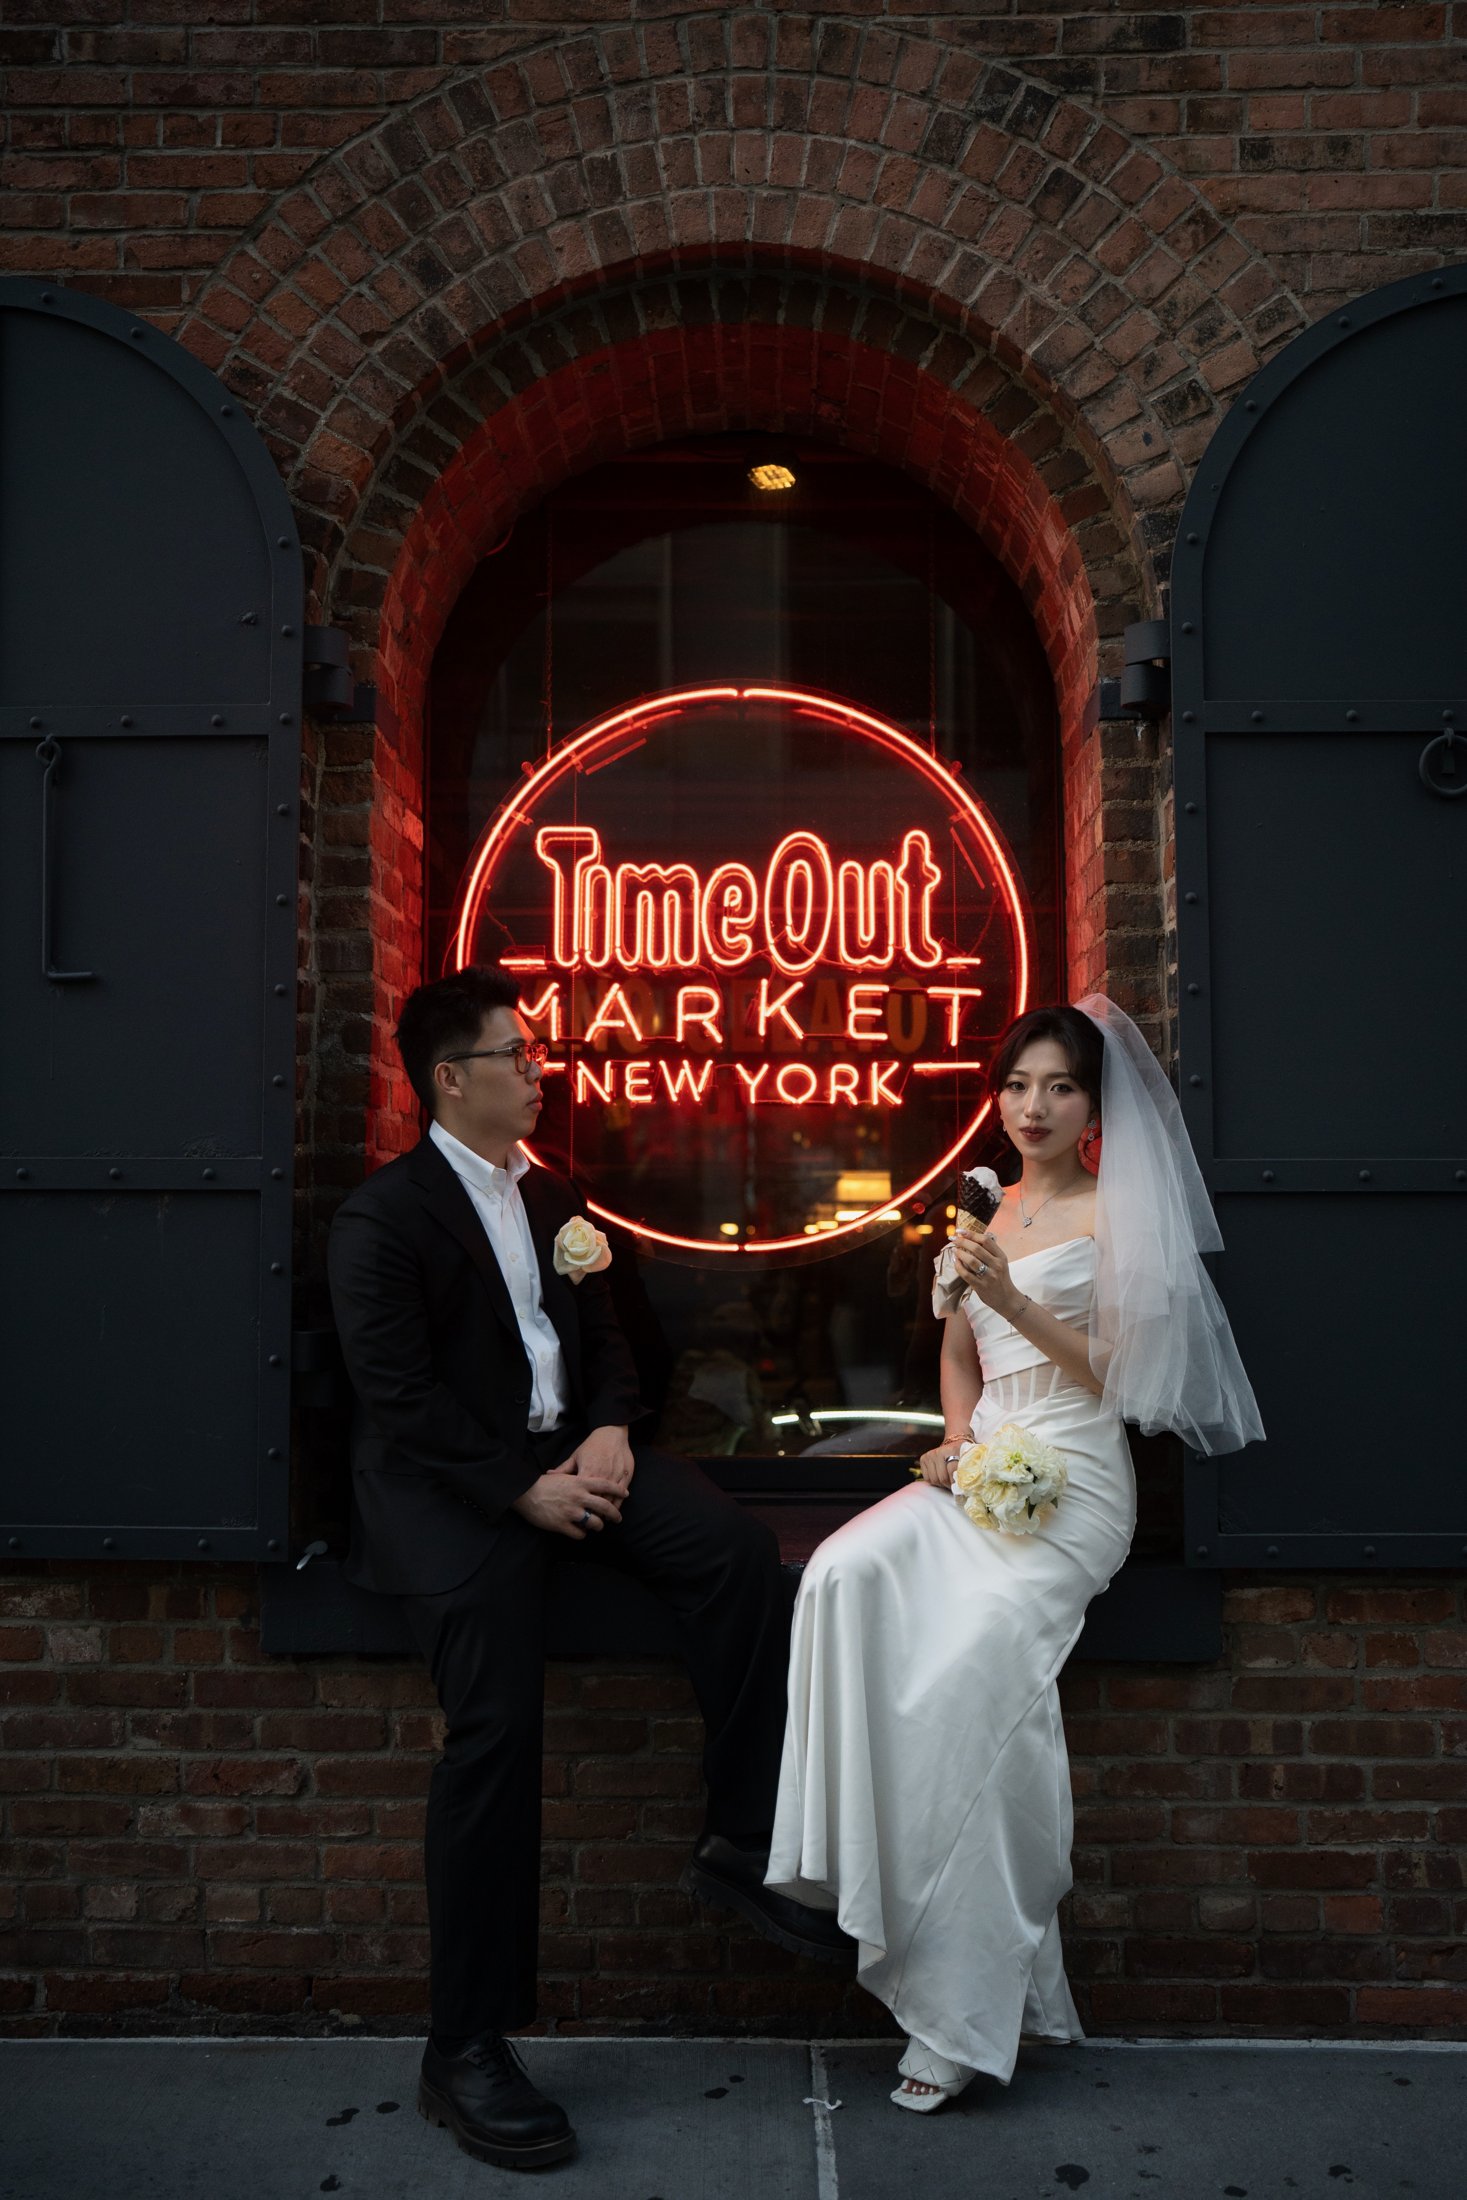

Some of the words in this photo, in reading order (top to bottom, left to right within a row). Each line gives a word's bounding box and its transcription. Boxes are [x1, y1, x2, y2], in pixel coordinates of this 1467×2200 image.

[518, 978, 983, 1047] MARKET
[577, 1059, 714, 1103] NEW
[735, 1061, 903, 1105] YORK
